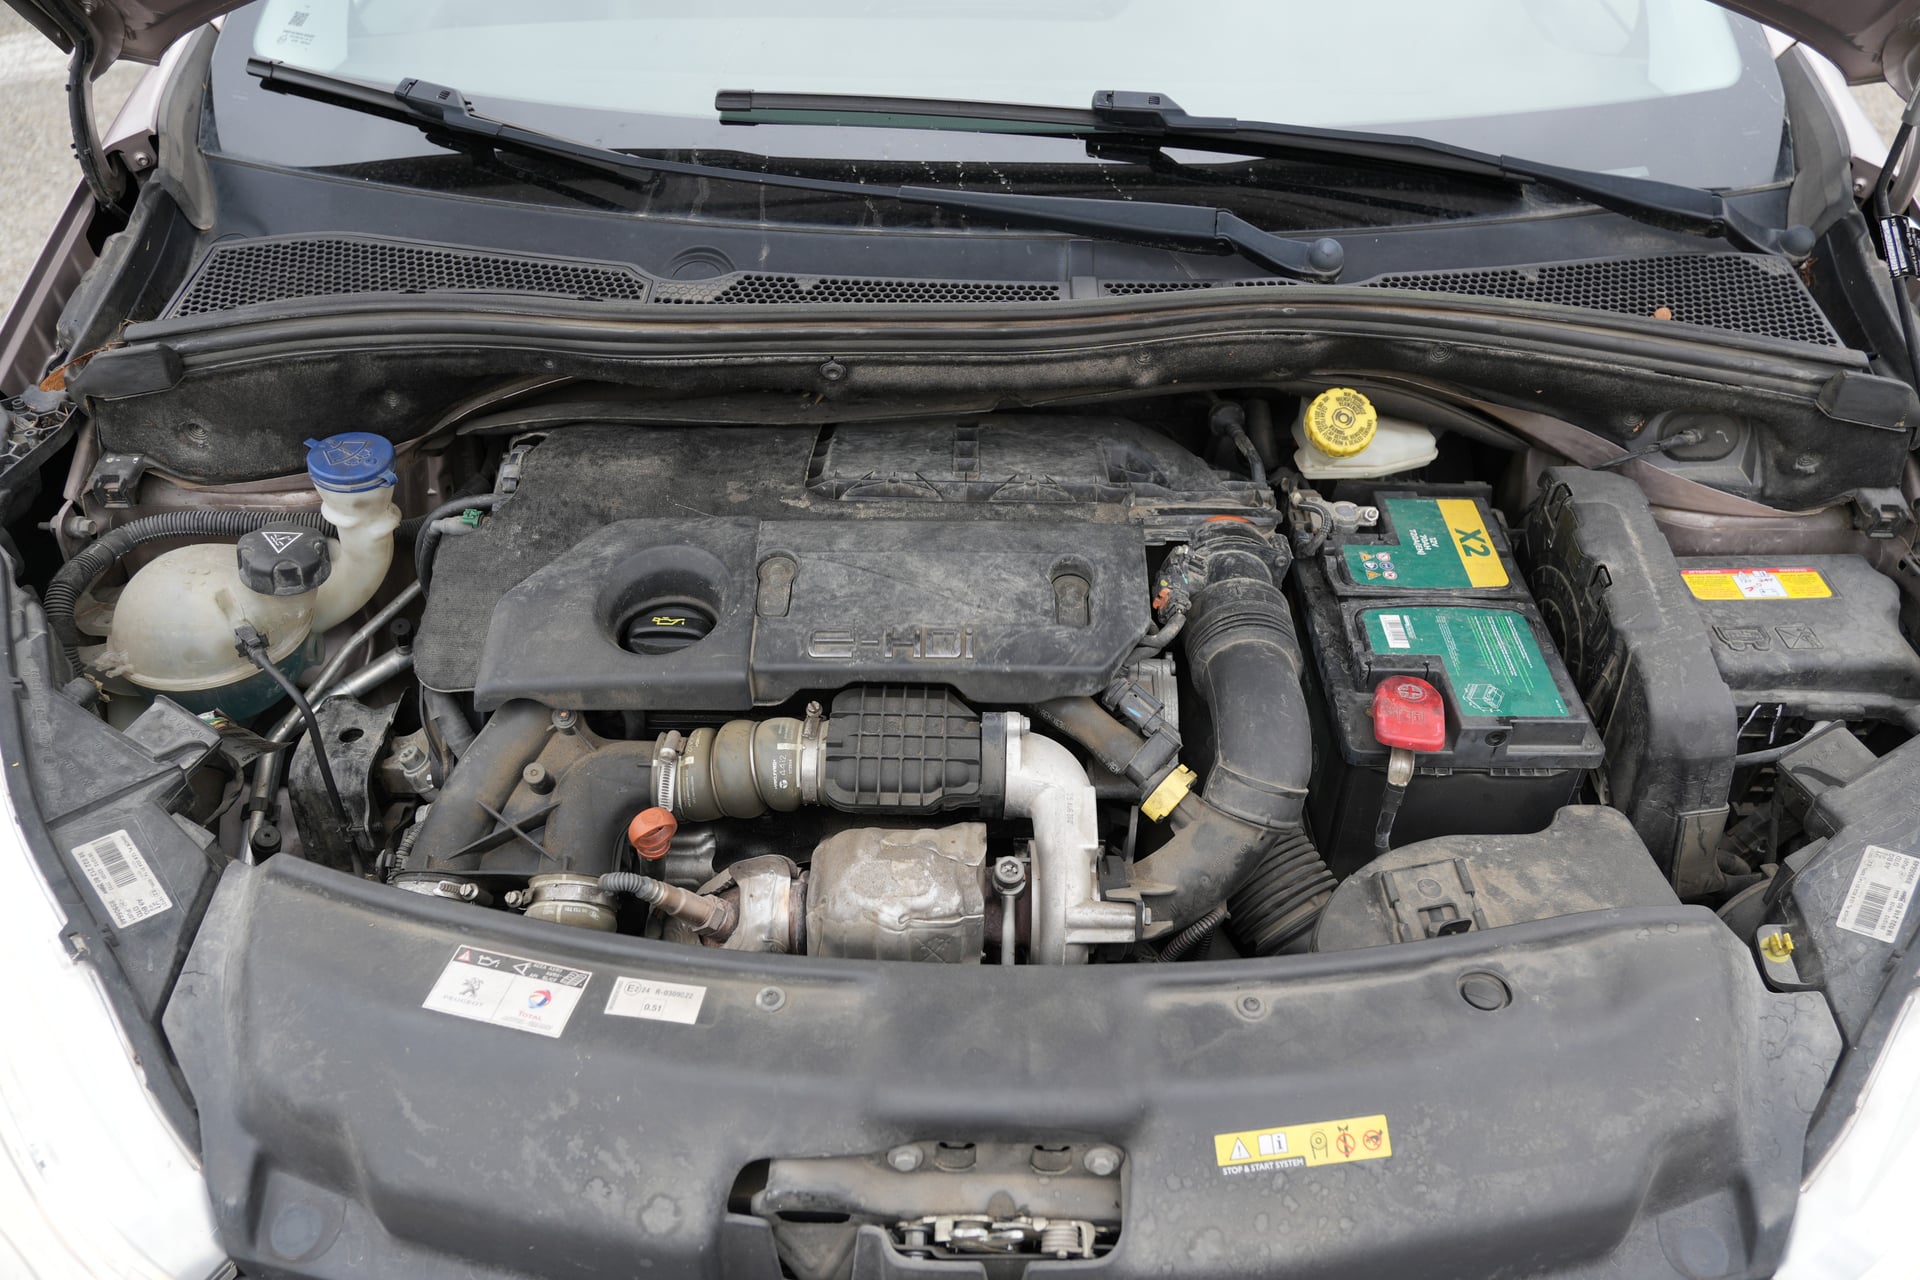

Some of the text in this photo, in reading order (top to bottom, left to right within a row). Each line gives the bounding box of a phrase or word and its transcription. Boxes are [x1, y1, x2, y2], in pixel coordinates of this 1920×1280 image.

[1455, 528, 1491, 557] X2
[643, 1003, 662, 1012] 0.51
[1222, 1158, 1305, 1176] STOP & START SYSTEM
